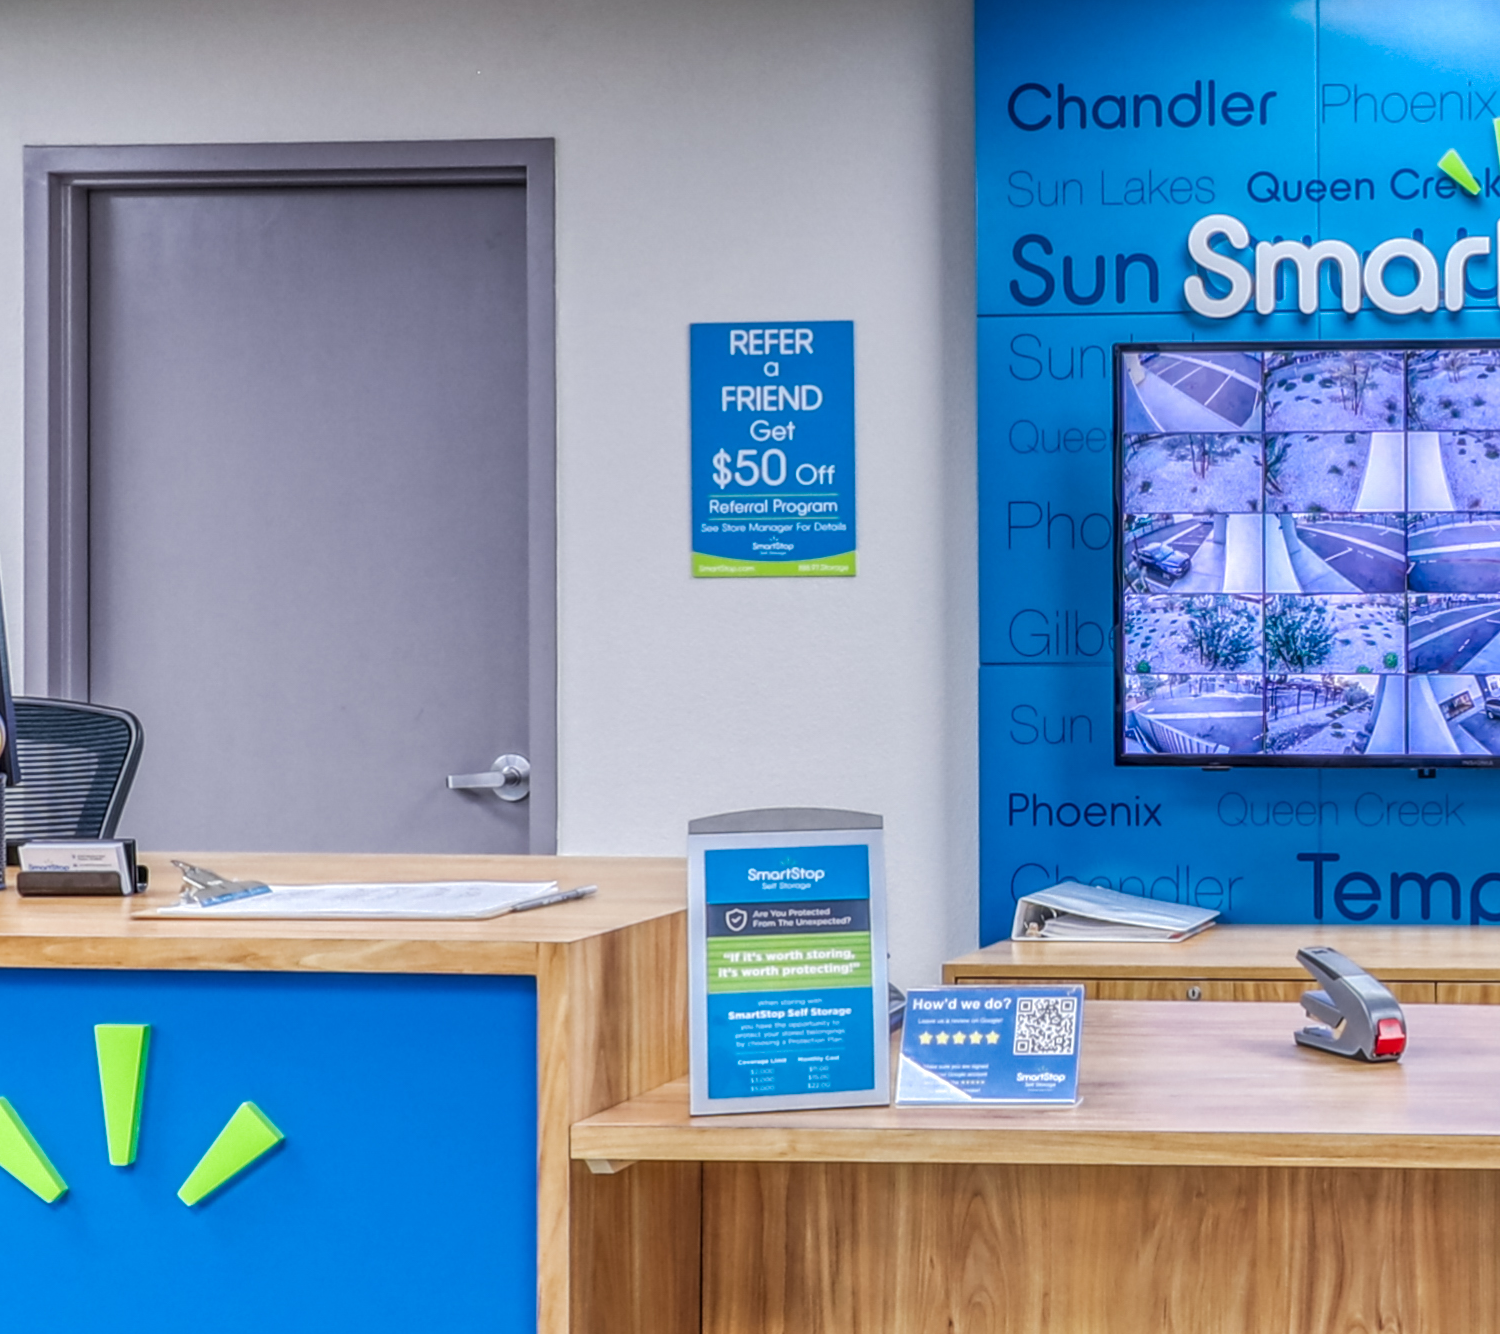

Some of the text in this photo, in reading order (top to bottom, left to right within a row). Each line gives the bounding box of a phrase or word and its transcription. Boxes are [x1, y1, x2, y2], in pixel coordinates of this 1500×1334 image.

[1007, 79, 1278, 131] Chandler
[1321, 81, 1497, 125] Phoenix
[1007, 169, 1217, 208] Sun Lakes
[1247, 170, 1376, 203] Queen
[1009, 233, 1160, 308] Sun
[729, 328, 814, 356] REFER
[763, 361, 780, 378] a
[1008, 333, 1106, 382] Sun
[721, 384, 824, 412] FRIEND
[749, 419, 796, 442] Get
[1008, 419, 1112, 455] Quee
[711, 447, 836, 490] $50 Off
[708, 498, 839, 517] Referral Program
[700, 521, 848, 534] See Store Manager For Details
[752, 542, 795, 551] SmartStop
[1008, 704, 1094, 745] Sun
[1008, 793, 1162, 827] Phoenix
[1216, 791, 1466, 827] Queen Creek
[748, 866, 826, 883] SmartStop
[752, 907, 831, 919] Are You Protected
[752, 916, 852, 929] From The Unexpected?
[765, 950, 803, 961] worth
[741, 965, 779, 977] worth
[727, 1007, 853, 1021] SmartStop Self Storage
[912, 997, 1012, 1011] How'd we do?
[1016, 1071, 1066, 1083] SmartStop
